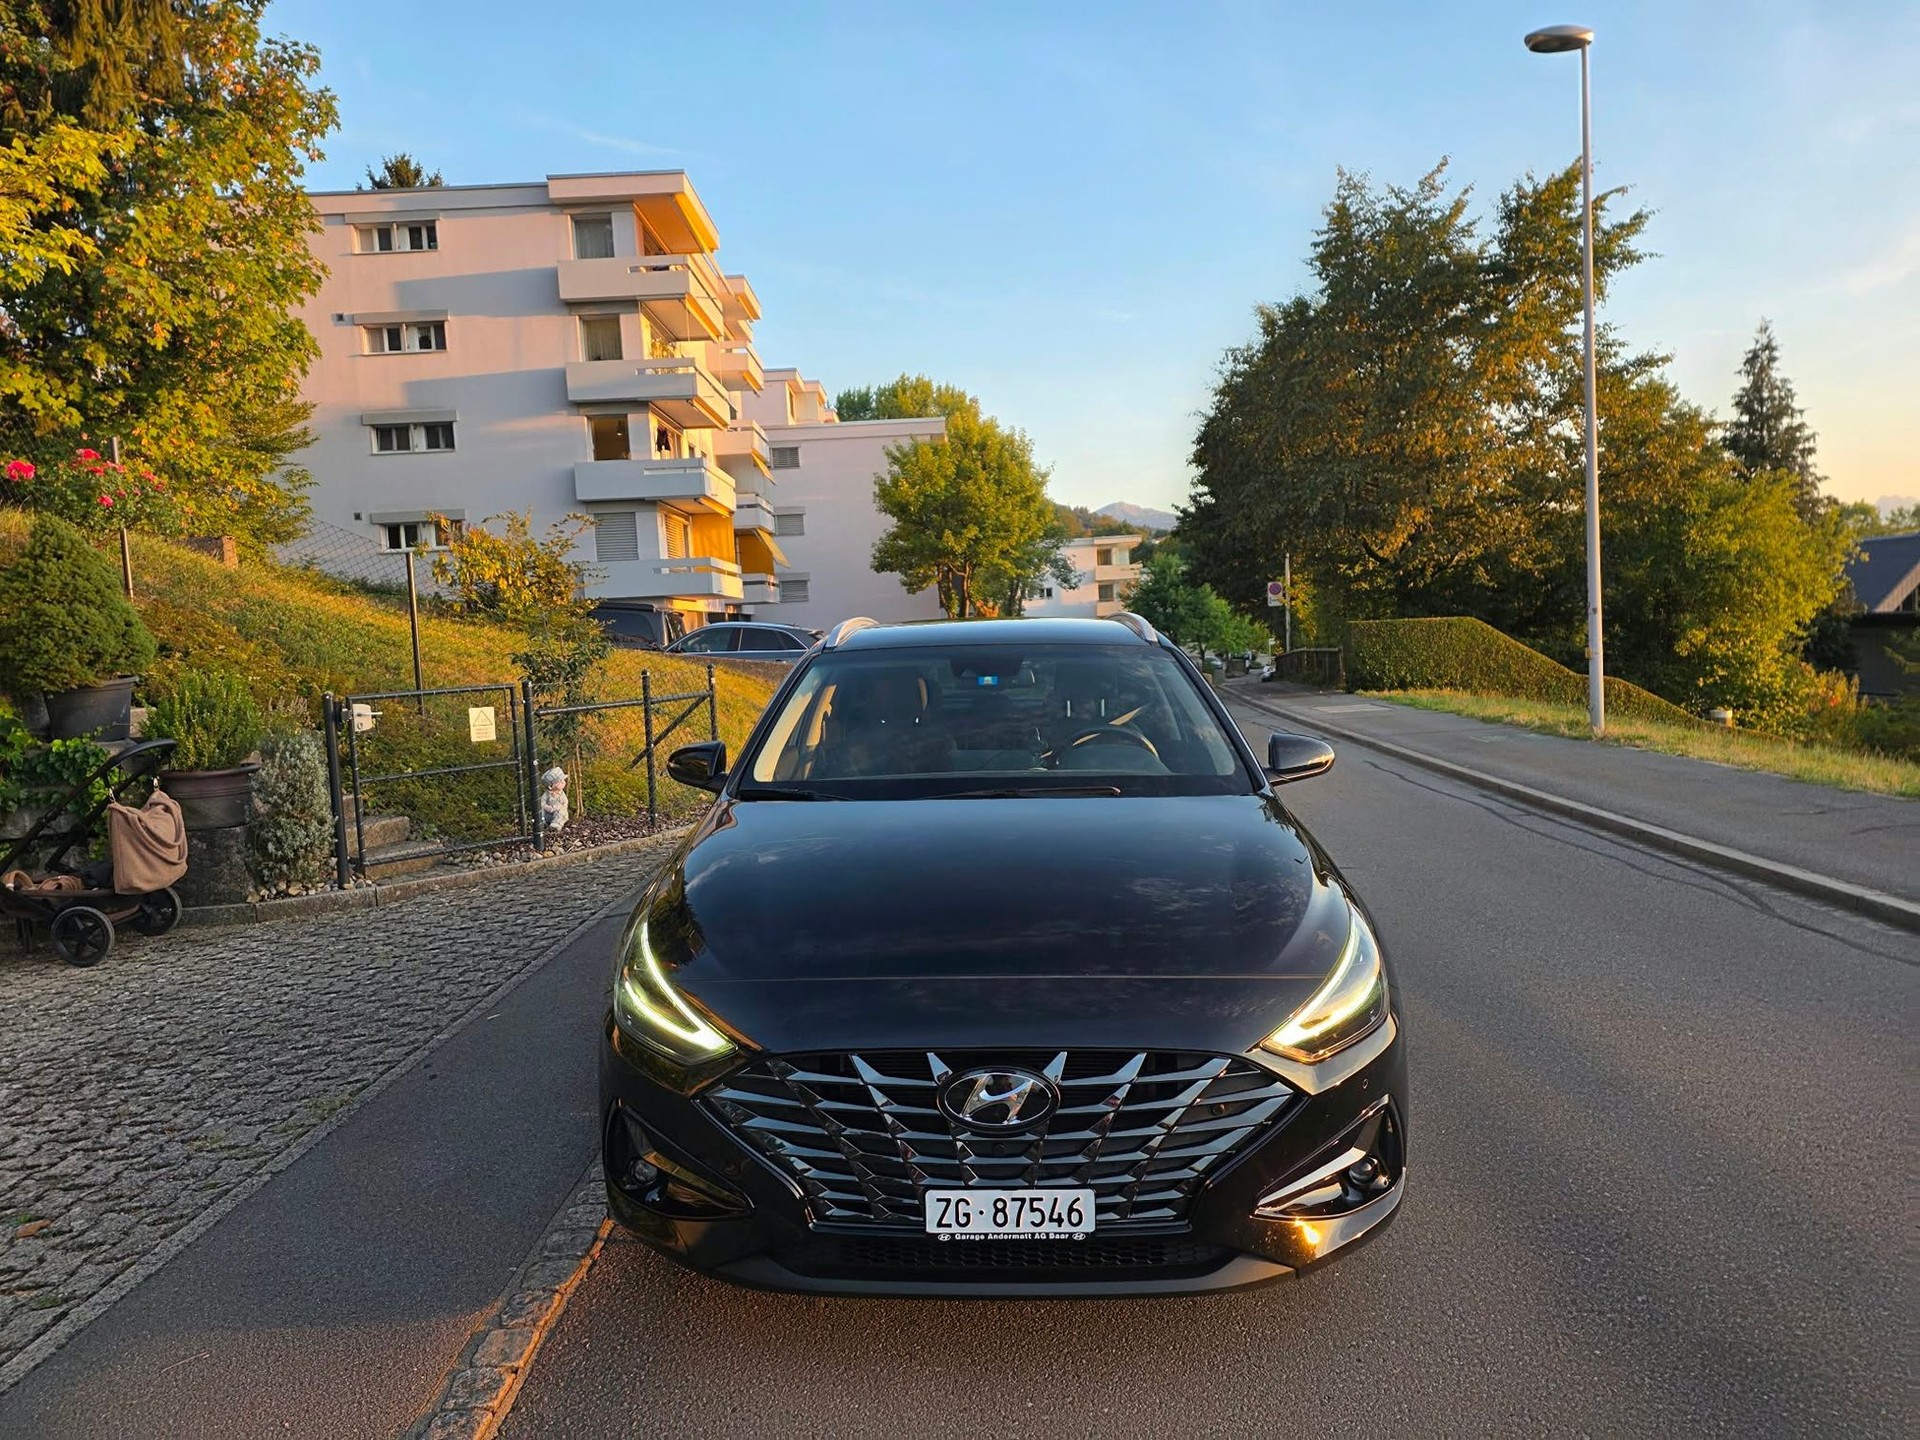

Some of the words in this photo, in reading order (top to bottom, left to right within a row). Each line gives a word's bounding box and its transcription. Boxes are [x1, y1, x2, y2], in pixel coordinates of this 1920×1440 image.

[954, 1233, 985, 1241] Garage
[1034, 1232, 1047, 1240] AG
[1048, 1232, 1070, 1240] Baar
